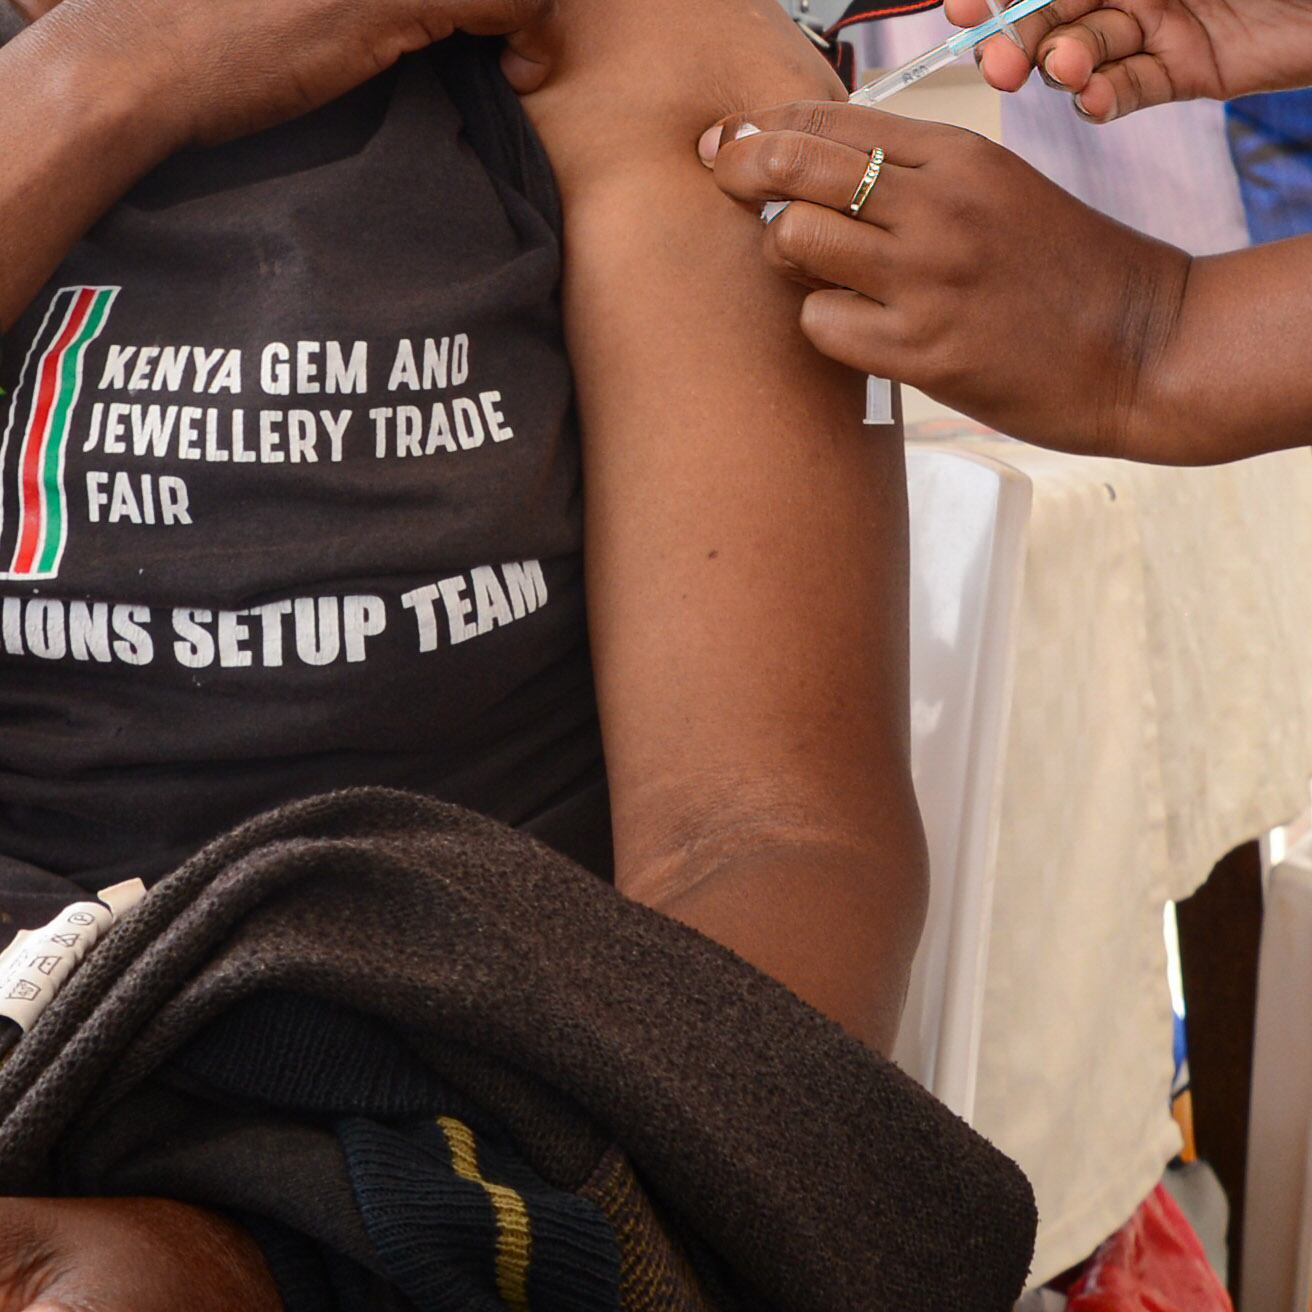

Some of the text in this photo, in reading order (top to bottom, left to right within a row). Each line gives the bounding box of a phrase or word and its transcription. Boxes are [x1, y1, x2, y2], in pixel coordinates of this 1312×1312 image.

[98, 333, 470, 396] KENYA GEM AND
[84, 390, 514, 464] JEWELLERY TRADE
[87, 471, 193, 525] FAIR
[173, 595, 386, 668] SETUP
[403, 560, 549, 653] TEAM
